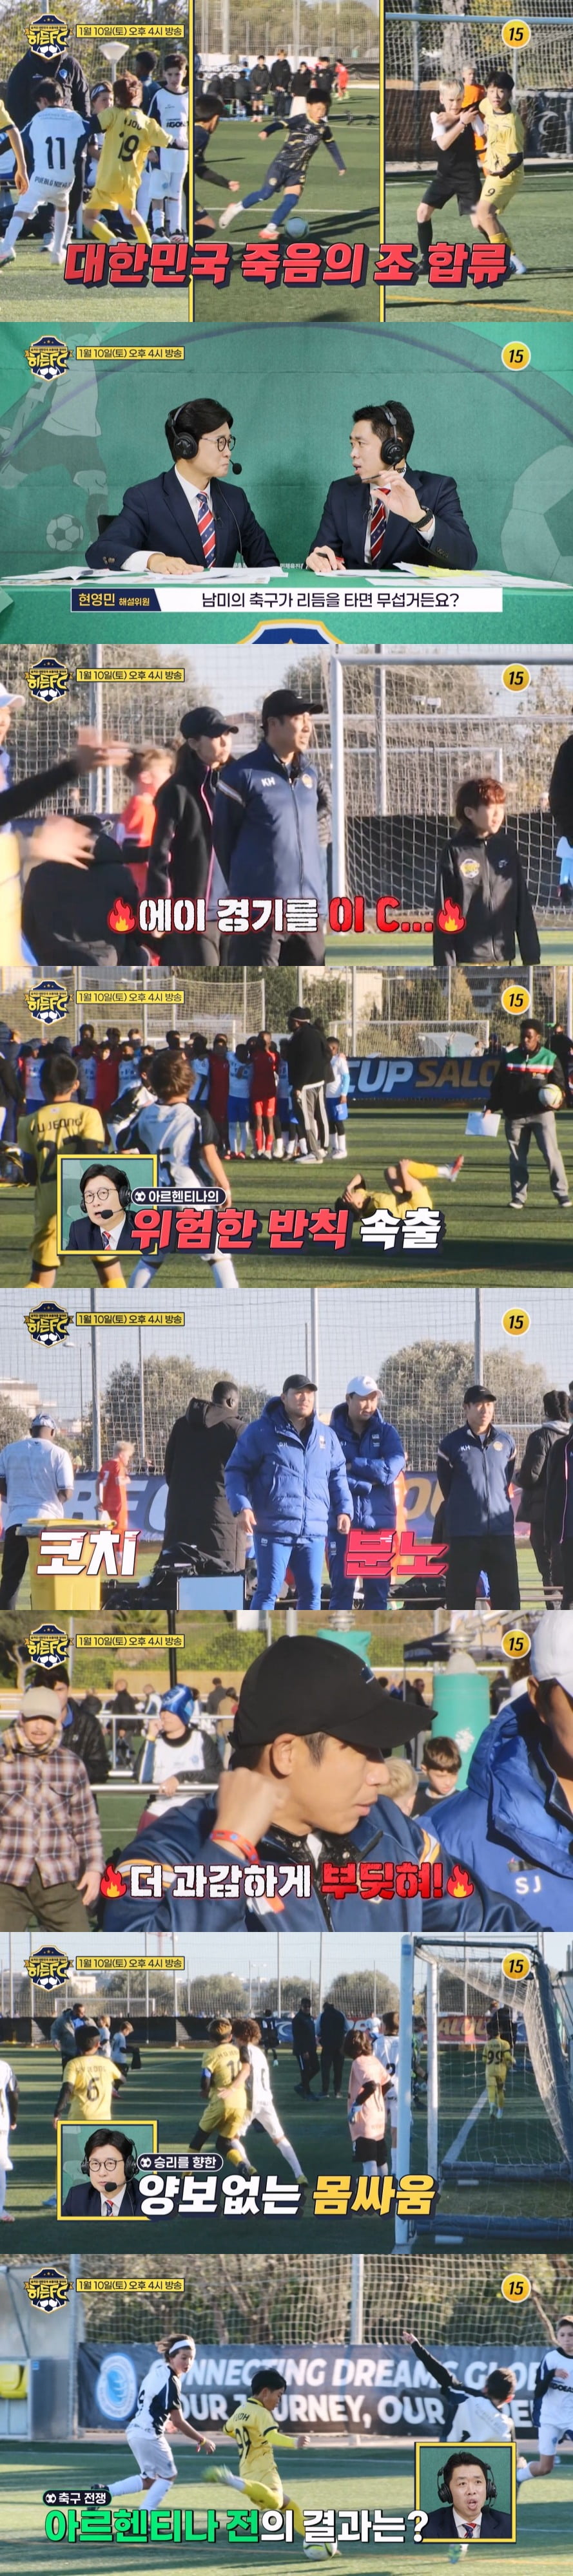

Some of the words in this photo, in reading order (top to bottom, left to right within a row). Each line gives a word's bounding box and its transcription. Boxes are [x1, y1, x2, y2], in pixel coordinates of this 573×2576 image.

[45, 137, 66, 169] 11
[117, 131, 140, 162] 19
[485, 187, 496, 197] 9
[261, 776, 276, 787] KH
[227, 2060, 241, 2081] 1
[87, 2077, 100, 2102] 6
[150, 2357, 327, 2387] NNECTING
[233, 2393, 372, 2429] URNEY,
[377, 2395, 445, 2425] OUR
